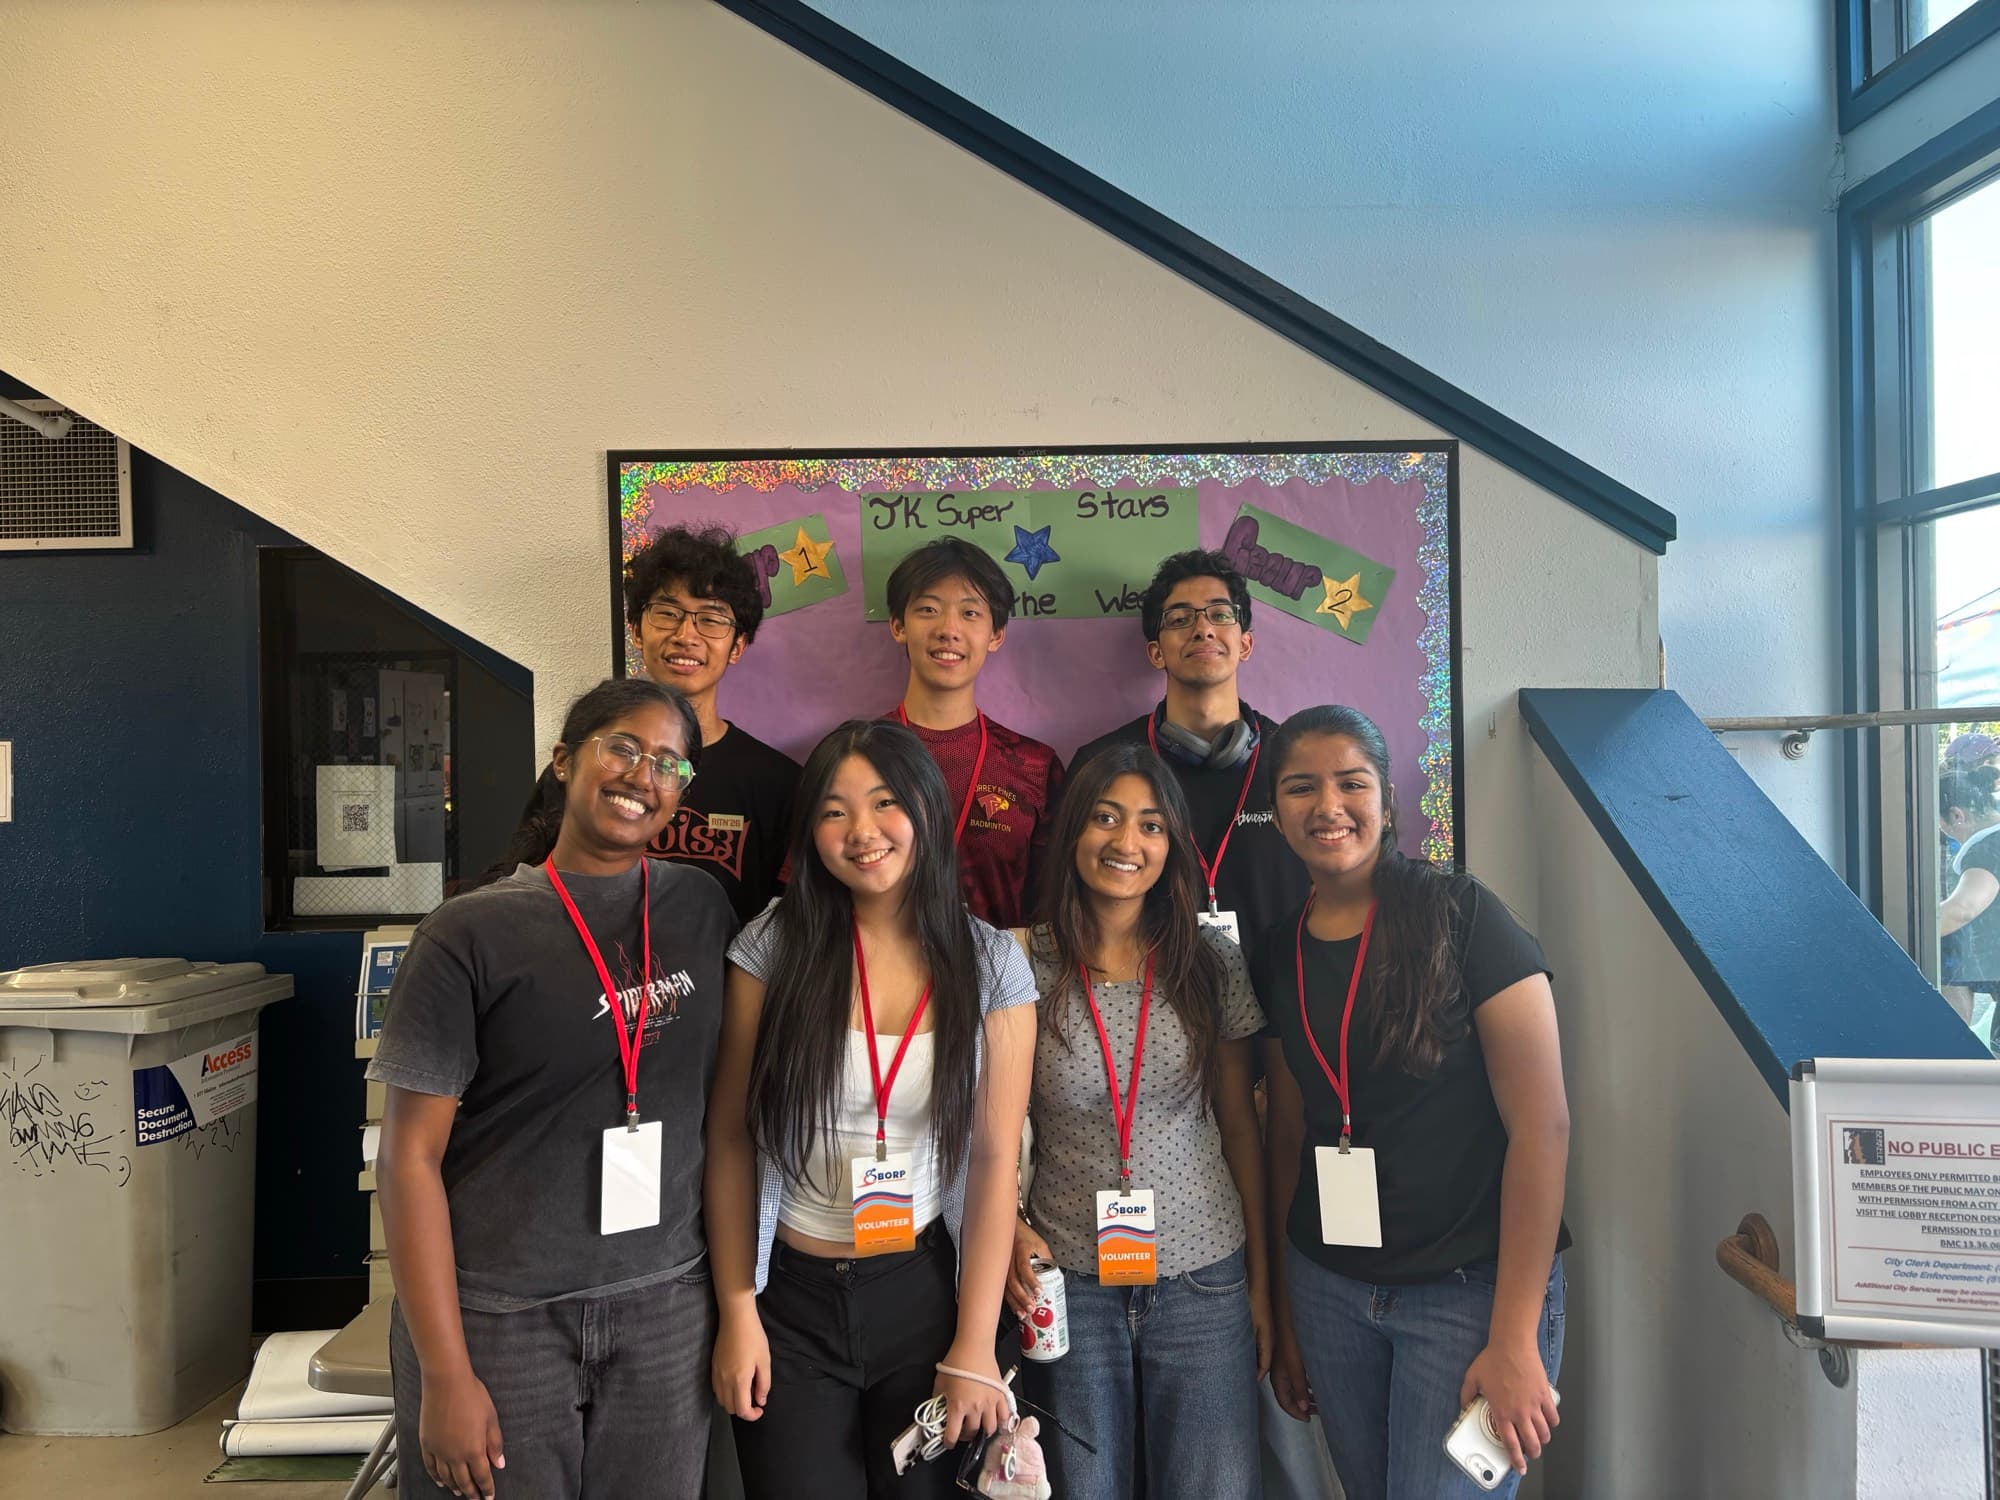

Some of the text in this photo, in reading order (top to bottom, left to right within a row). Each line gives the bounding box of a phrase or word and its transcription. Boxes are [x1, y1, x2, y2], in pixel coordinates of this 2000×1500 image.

[937, 494, 1014, 530] Super
[1077, 491, 1170, 520] Stars
[798, 547, 818, 573] 1
[1095, 584, 1149, 614] Wee
[1327, 589, 1353, 614] 2
[970, 819, 1011, 832] BADMINTON
[201, 1044, 252, 1077] Access
[138, 1104, 175, 1119] Secure
[138, 1109, 188, 1130] Document
[139, 1120, 193, 1142] Destruction
[1888, 1141, 1914, 1154] NO
[1920, 1142, 1985, 1157] PUBLIC
[878, 1170, 906, 1180] BORP
[1860, 1169, 1912, 1179] EMPLOYEES
[1913, 1171, 1937, 1180] ONLY
[1940, 1172, 1990, 1182] PERMITTED
[1852, 1182, 1897, 1191] MEMBERS
[1898, 1184, 1910, 1192] OF
[1912, 1185, 1929, 1193] THE
[1931, 1186, 1962, 1195] PUBLIC
[1964, 1187, 1985, 1196] MAY
[1858, 1195, 1882, 1204] WITH
[1884, 1196, 1939, 1207] PERMISSION
[1941, 1199, 1968, 1208] FROM
[1978, 1201, 1998, 1210] CITY
[1119, 1206, 1147, 1214] BORP
[1856, 1208, 1878, 1217] VISIT
[1880, 1209, 1896, 1218] THE
[1898, 1211, 1927, 1220] LOBBY
[1929, 1212, 1978, 1222] RECEPTION
[857, 1218, 910, 1231] VOLUNTEER
[1921, 1225, 1977, 1235] PERMISSION
[1979, 1228, 1992, 1236] TO
[1100, 1252, 1151, 1261] VOLUNTEER
[1884, 1257, 1903, 1267] City
[1905, 1259, 1930, 1268] Clerk
[1893, 1270, 1918, 1279] Code
